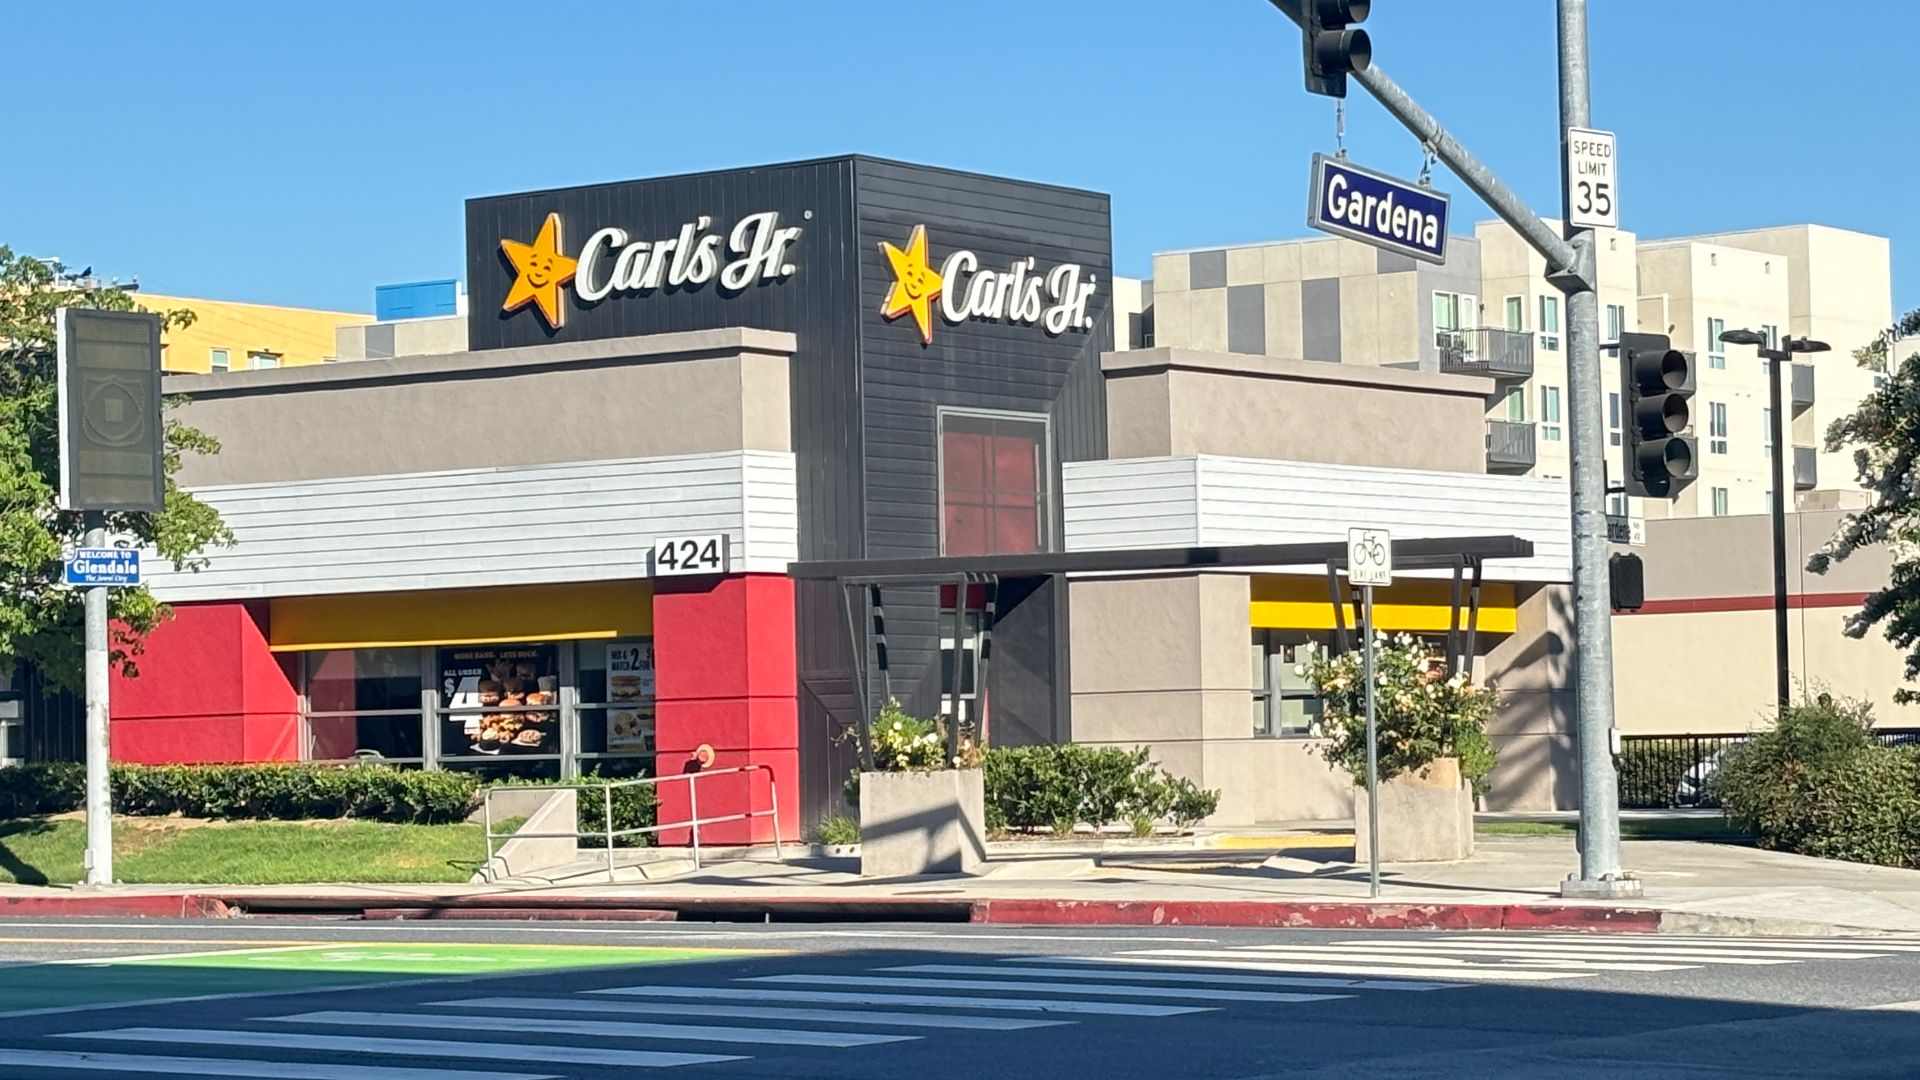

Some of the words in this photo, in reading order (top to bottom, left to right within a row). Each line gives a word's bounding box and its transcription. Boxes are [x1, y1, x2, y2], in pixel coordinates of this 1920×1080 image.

[1573, 140, 1612, 158] SPEED
[1577, 160, 1608, 177] LIMIT
[1576, 180, 1611, 216] 35
[1326, 172, 1439, 249] Gardena
[574, 215, 723, 301] Carl's
[720, 211, 803, 290] Jr.
[940, 250, 1043, 322] Carl's
[1041, 263, 1097, 334] Jr.
[80, 550, 119, 559] WELCOME
[120, 550, 132, 559] TO
[657, 538, 721, 570] 424
[73, 559, 138, 575] Glendale
[85, 574, 97, 582] The
[114, 574, 128, 583] City
[630, 647, 640, 671] 2
[443, 669, 457, 677] ALL
[457, 668, 483, 677] UNDER
